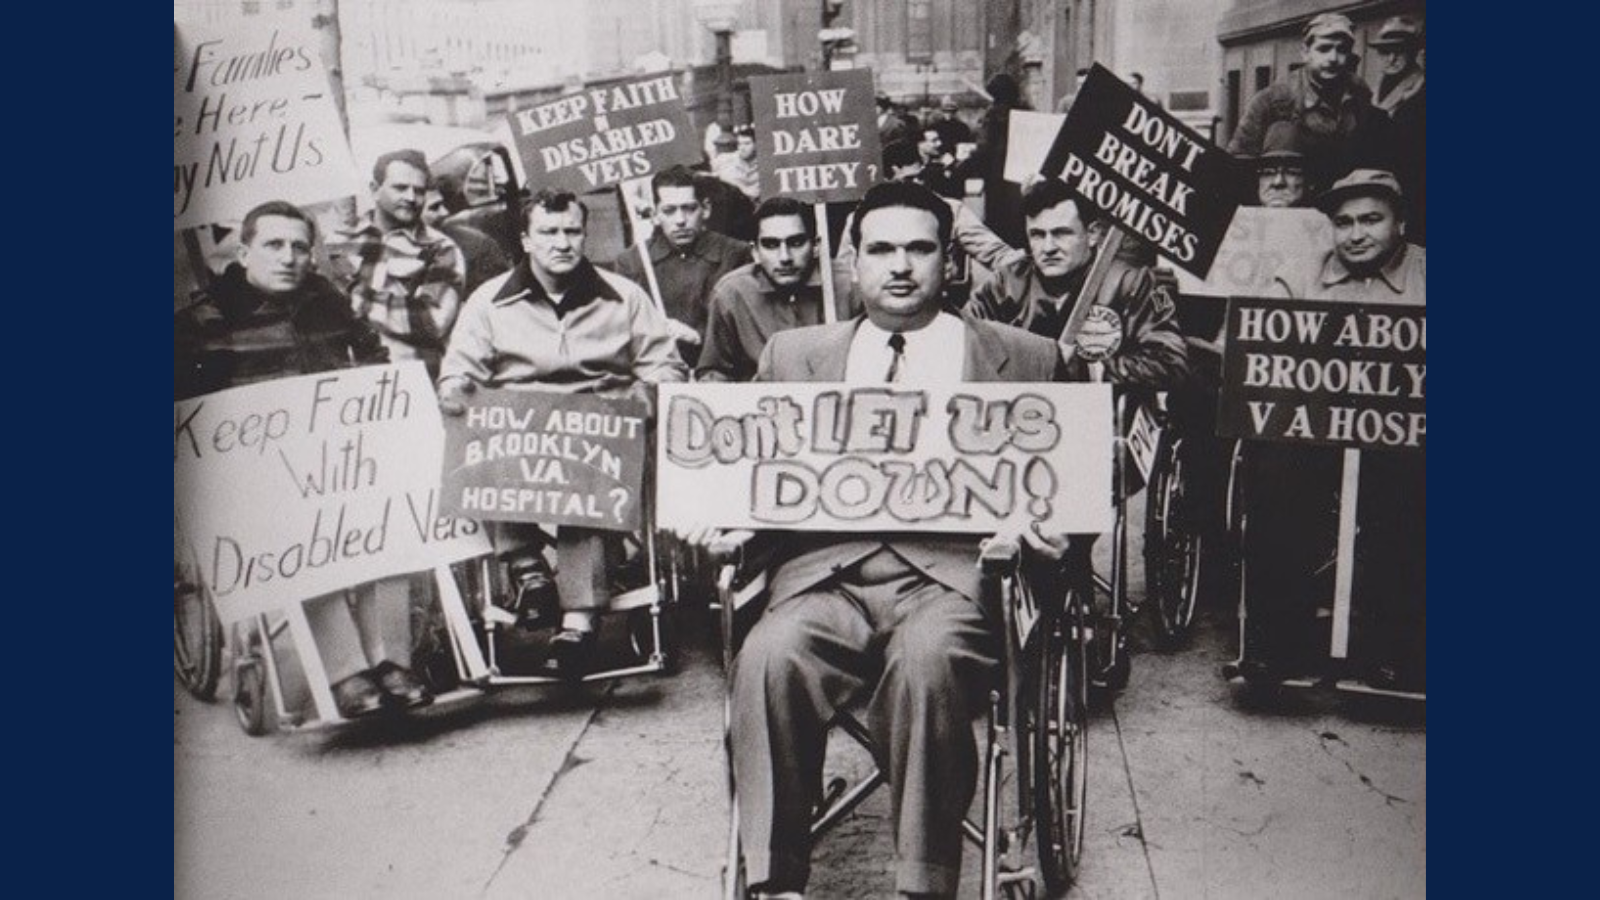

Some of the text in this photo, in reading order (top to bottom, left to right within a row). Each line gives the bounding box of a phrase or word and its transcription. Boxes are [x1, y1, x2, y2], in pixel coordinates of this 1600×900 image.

[186, 30, 312, 93] Families
[195, 94, 288, 135] Here
[515, 95, 589, 136] KEEP
[594, 76, 679, 114] FAITH
[774, 88, 847, 119] HOW
[205, 134, 269, 188] Not
[271, 122, 323, 174] Us
[540, 118, 676, 173] DISABLED
[772, 123, 862, 155] DARE
[1122, 101, 1206, 173] DON'T
[579, 150, 652, 187] VETS
[1094, 131, 1196, 216] BREAK
[1057, 153, 1200, 264] PROMISES
[1236, 306, 1329, 345] HOW
[1243, 353, 1426, 399] BROOKLY
[174, 369, 411, 459] Keep Faith
[466, 405, 642, 440] HOW ABOUT
[665, 392, 805, 469] Don't
[811, 387, 929, 455] LET
[1247, 401, 1426, 448] V A HOSP
[278, 430, 378, 499] With
[464, 432, 622, 481] BROOKLYN
[461, 486, 629, 524] HOSPITAL?
[749, 455, 1059, 524] DOWN!
[211, 497, 392, 597] Disabled
